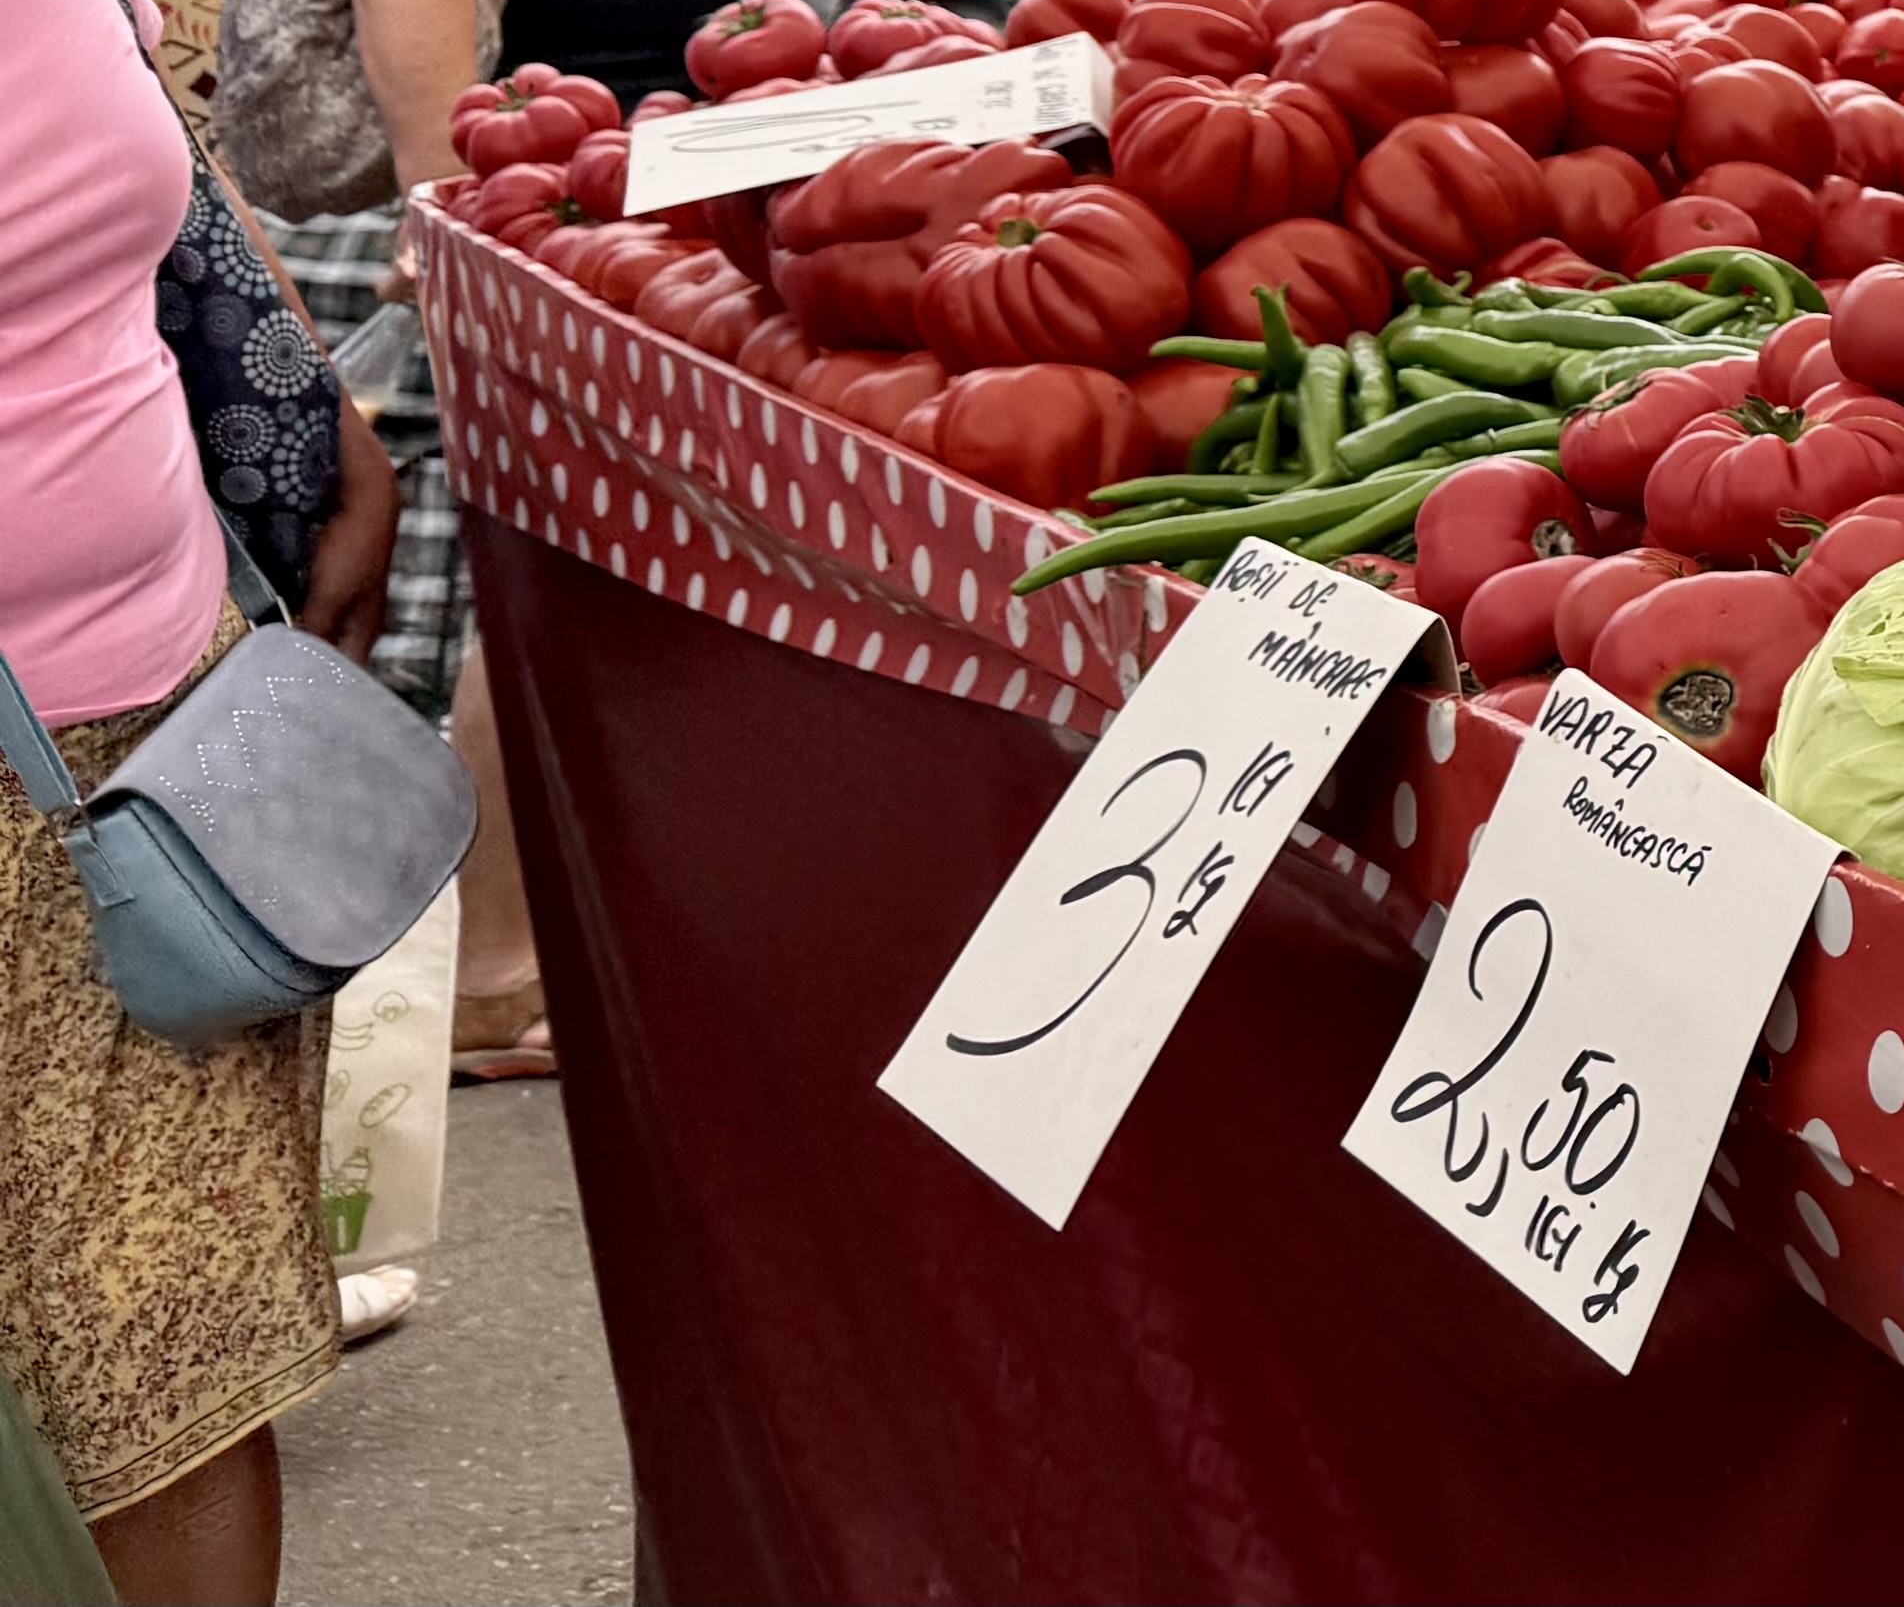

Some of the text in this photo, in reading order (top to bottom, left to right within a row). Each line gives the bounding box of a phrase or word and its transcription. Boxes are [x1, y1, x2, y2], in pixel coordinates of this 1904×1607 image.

[1288, 579, 1339, 617] DE
[946, 747, 1208, 1057] 3
[1390, 897, 1641, 1218] 2,50
